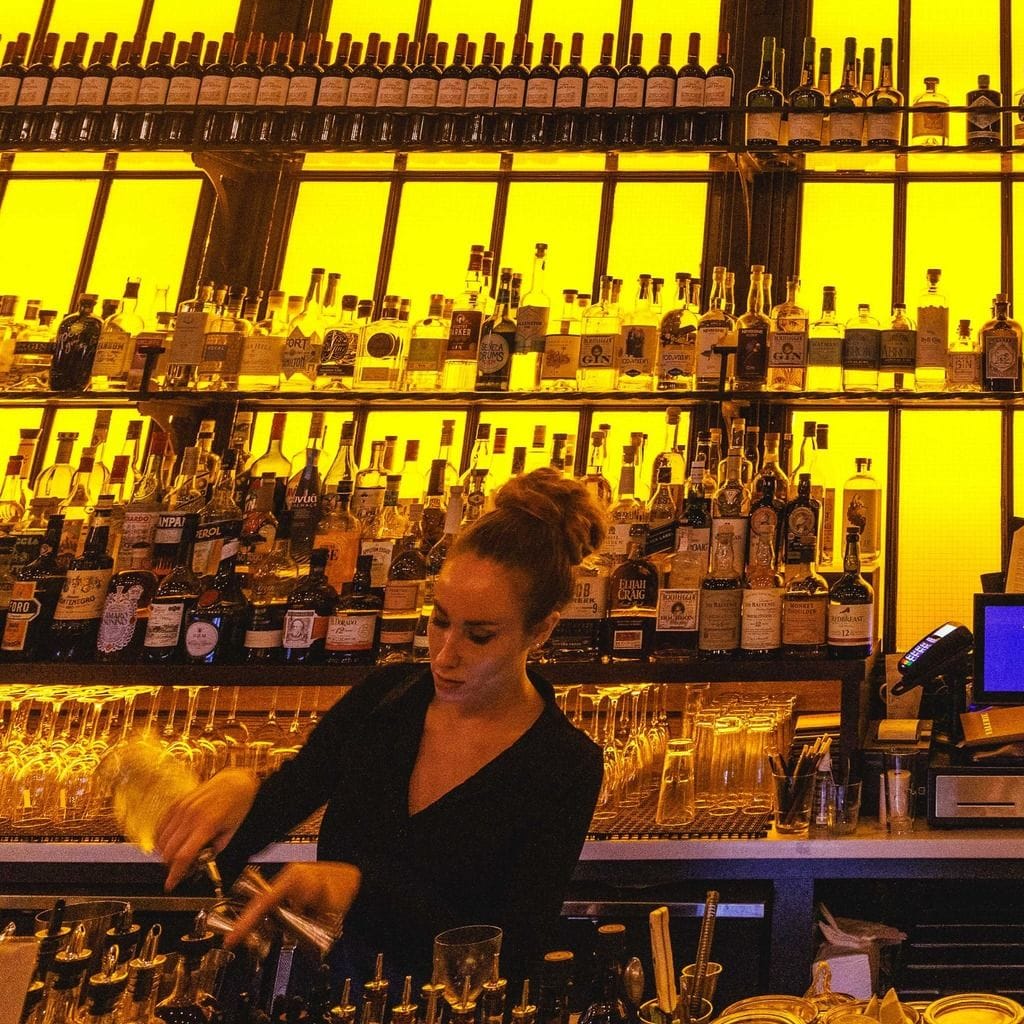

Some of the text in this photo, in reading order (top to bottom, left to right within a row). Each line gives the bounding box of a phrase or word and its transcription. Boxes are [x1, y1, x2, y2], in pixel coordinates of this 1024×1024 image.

[582, 354, 611, 365] GIN
[773, 352, 802, 361] GIN
[955, 359, 973, 369] GIN
[619, 578, 647, 590] ELIJAH
[617, 589, 647, 602] CRAIG
[591, 603, 598, 614] 9
[789, 602, 815, 610] MONKEY
[841, 629, 851, 638] 12
